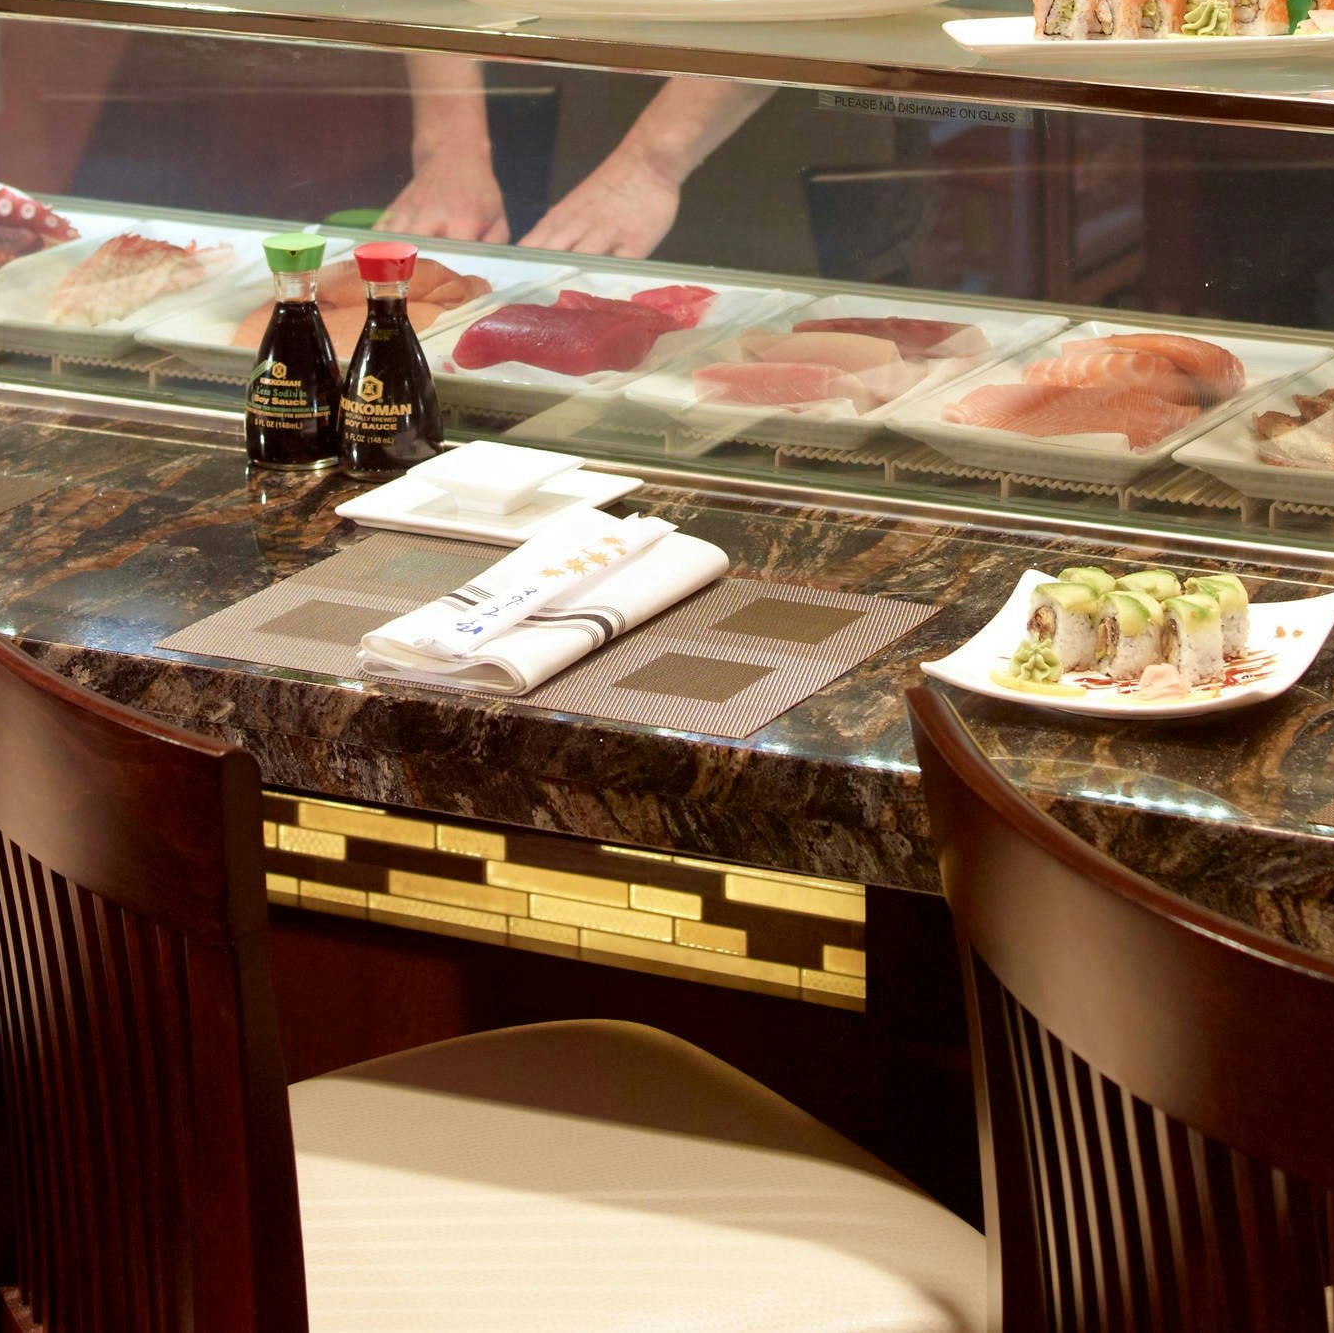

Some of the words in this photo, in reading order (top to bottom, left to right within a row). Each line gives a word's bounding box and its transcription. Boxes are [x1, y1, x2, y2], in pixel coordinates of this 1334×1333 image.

[834, 96, 876, 111] PLEASE
[879, 101, 896, 113] NO
[898, 102, 957, 119] DISHWARE
[959, 108, 976, 120] ON
[978, 110, 1016, 123] GLASS
[259, 377, 302, 387] KIKKOMAN
[271, 397, 307, 406] Sauce
[340, 396, 412, 416] KIKKOMAN
[344, 418, 360, 428] SOY
[361, 422, 398, 431] SAUCE
